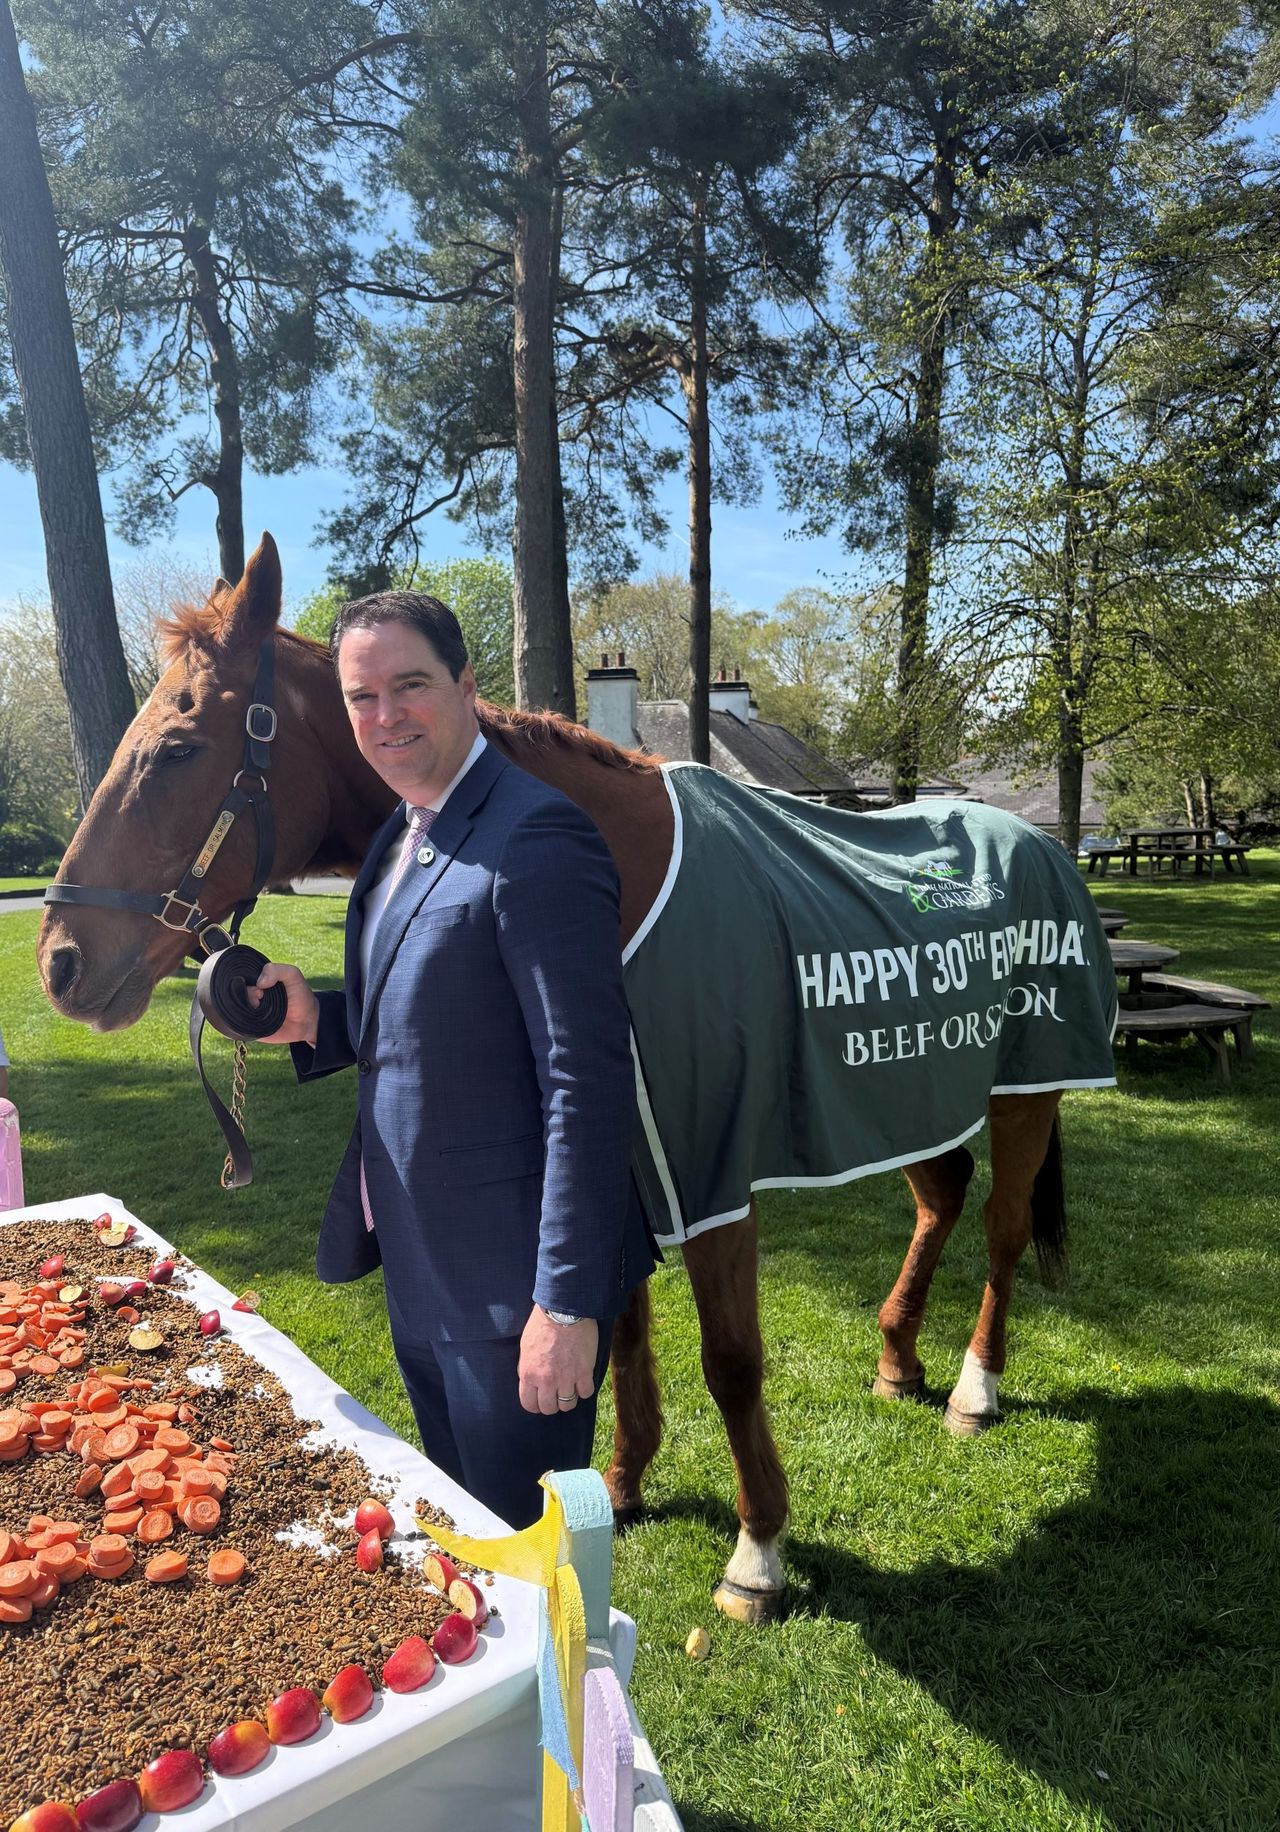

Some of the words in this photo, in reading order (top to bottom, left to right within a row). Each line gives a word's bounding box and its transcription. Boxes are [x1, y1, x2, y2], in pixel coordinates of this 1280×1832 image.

[932, 882, 1005, 909] GARDENS
[797, 944, 919, 1009] HAPPY
[926, 930, 986, 994] 30TH
[842, 1021, 935, 1066] BEEF
[941, 1011, 987, 1050] OR
